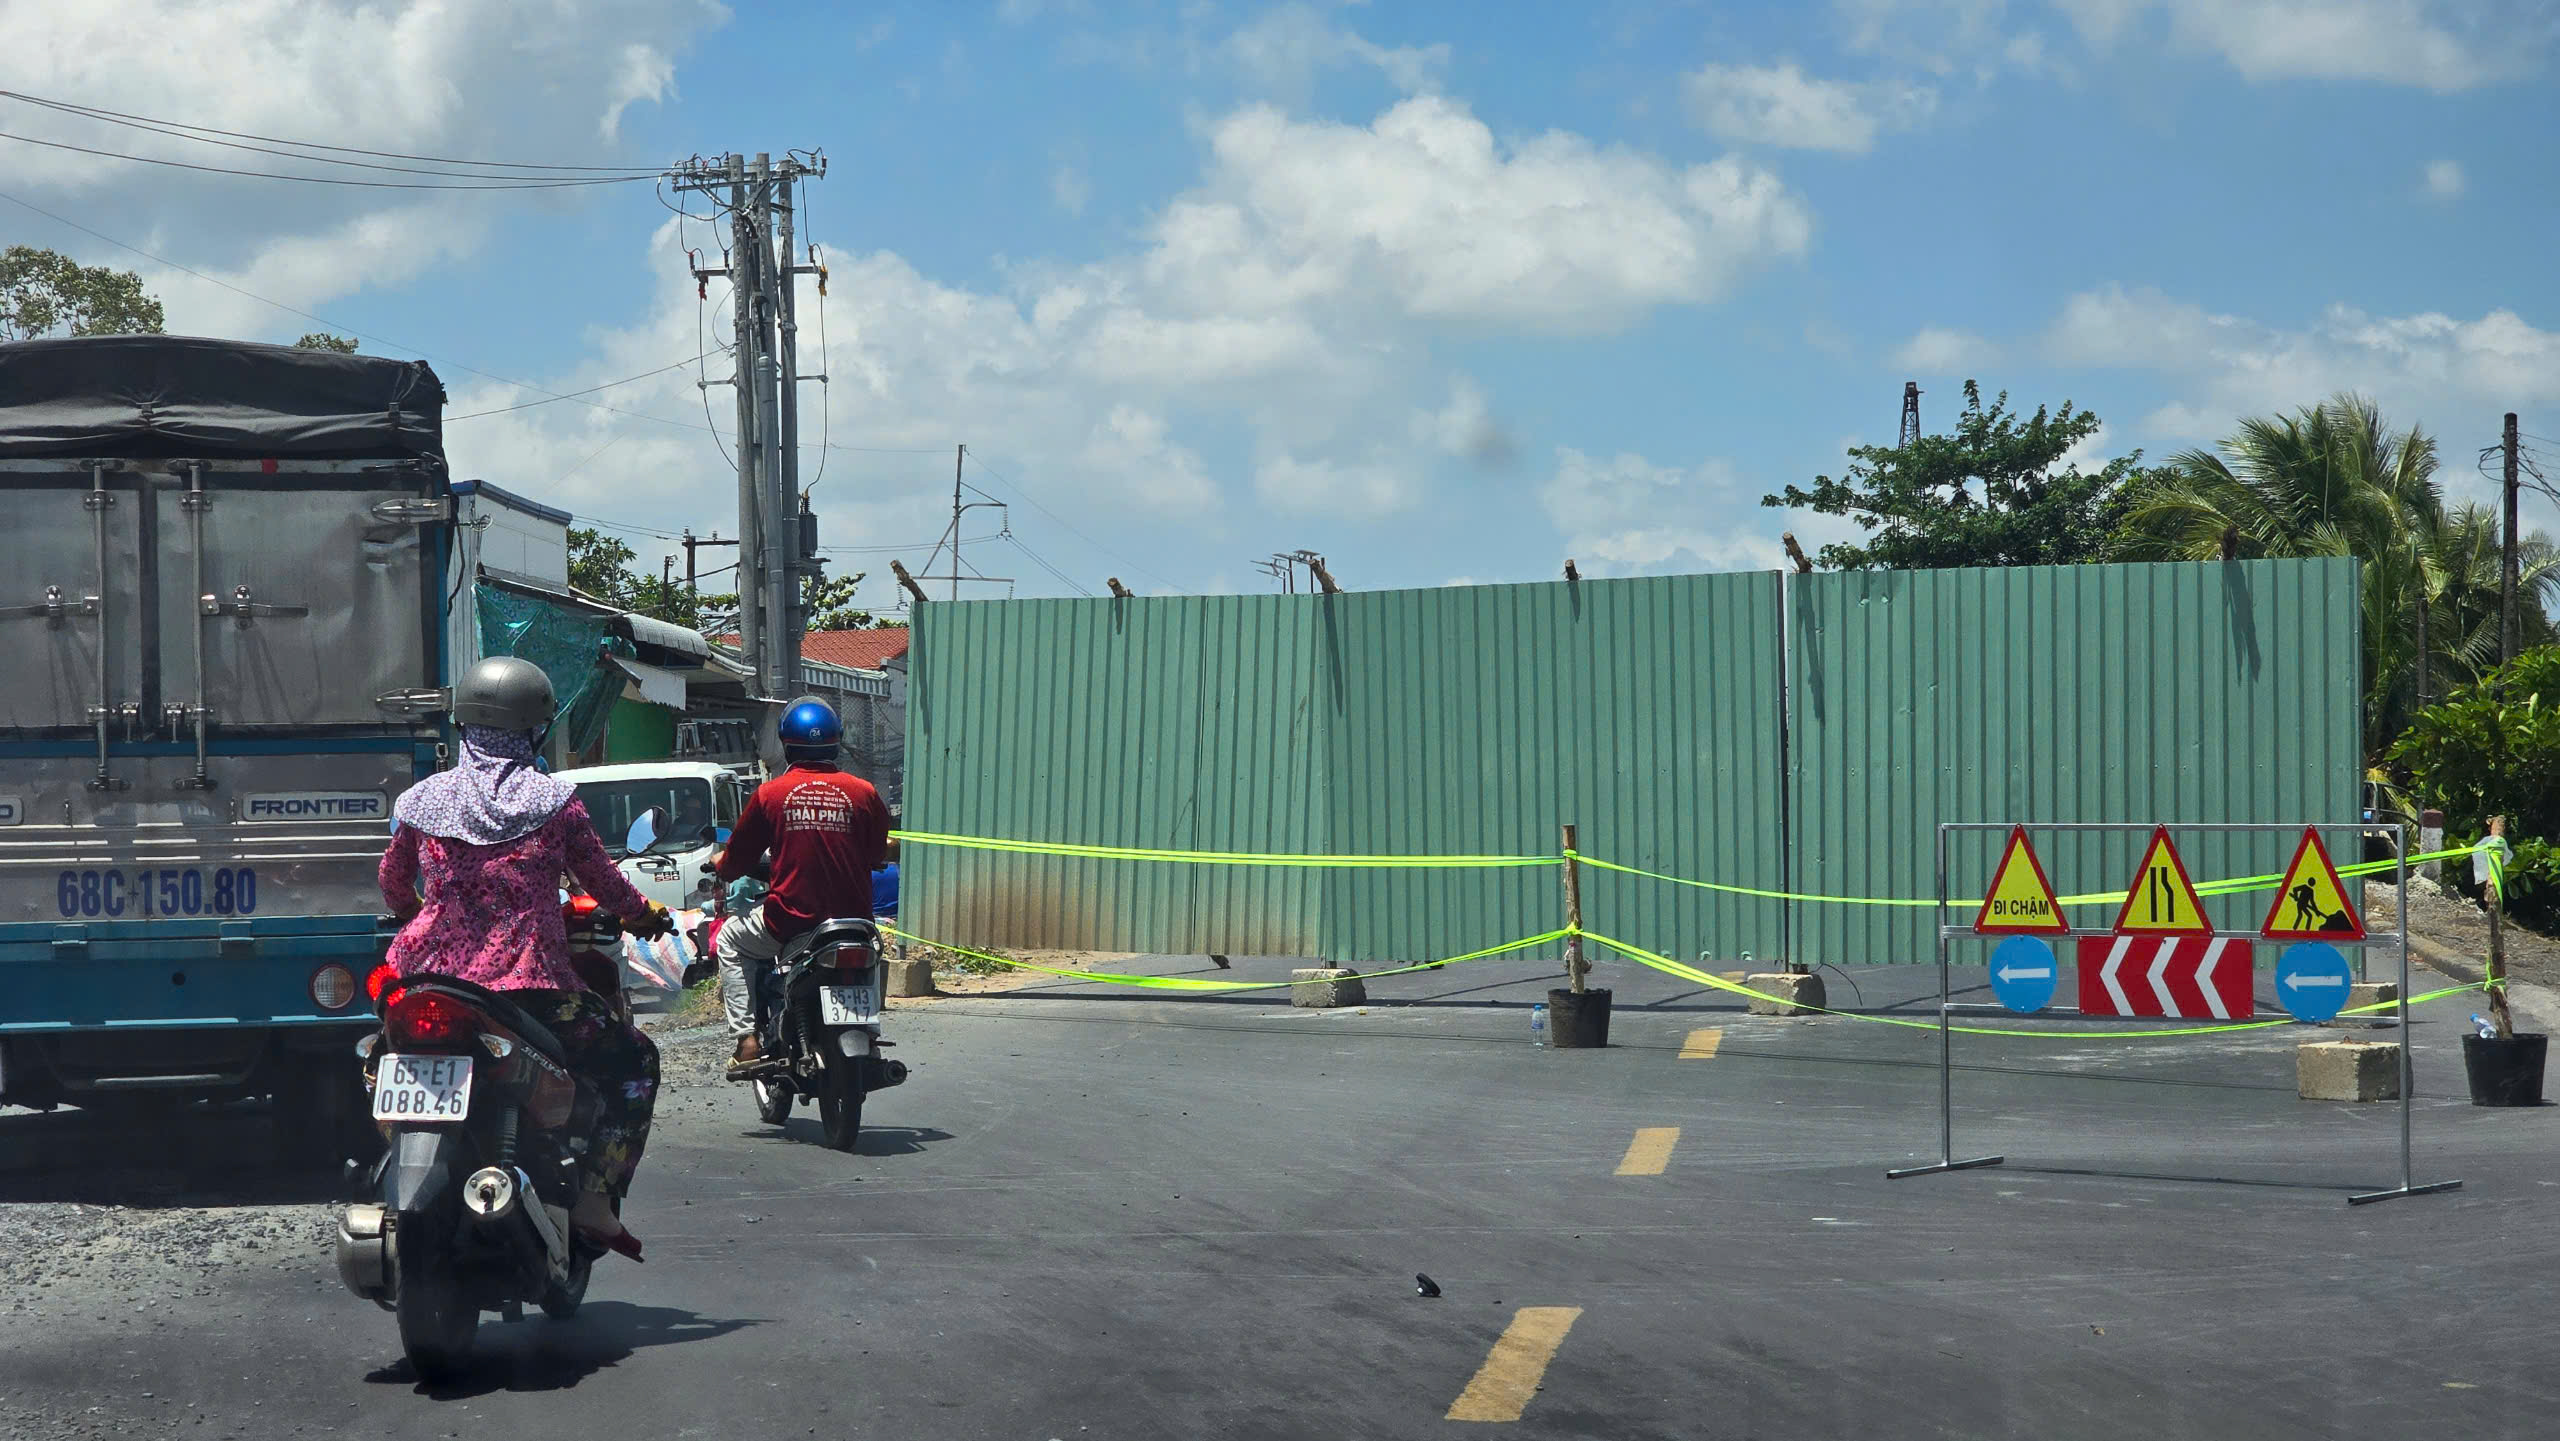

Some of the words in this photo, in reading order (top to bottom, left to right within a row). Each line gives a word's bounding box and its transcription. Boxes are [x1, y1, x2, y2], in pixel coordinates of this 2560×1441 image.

[251, 798, 379, 815] FRONTIER
[784, 806, 816, 821] THÁI
[818, 808, 854, 824] PHÁT
[1993, 900, 2007, 915] ĐI
[2010, 896, 2049, 919] CHẬM
[832, 1006, 870, 1022] 3717
[381, 1089, 463, 1115] 088.46
